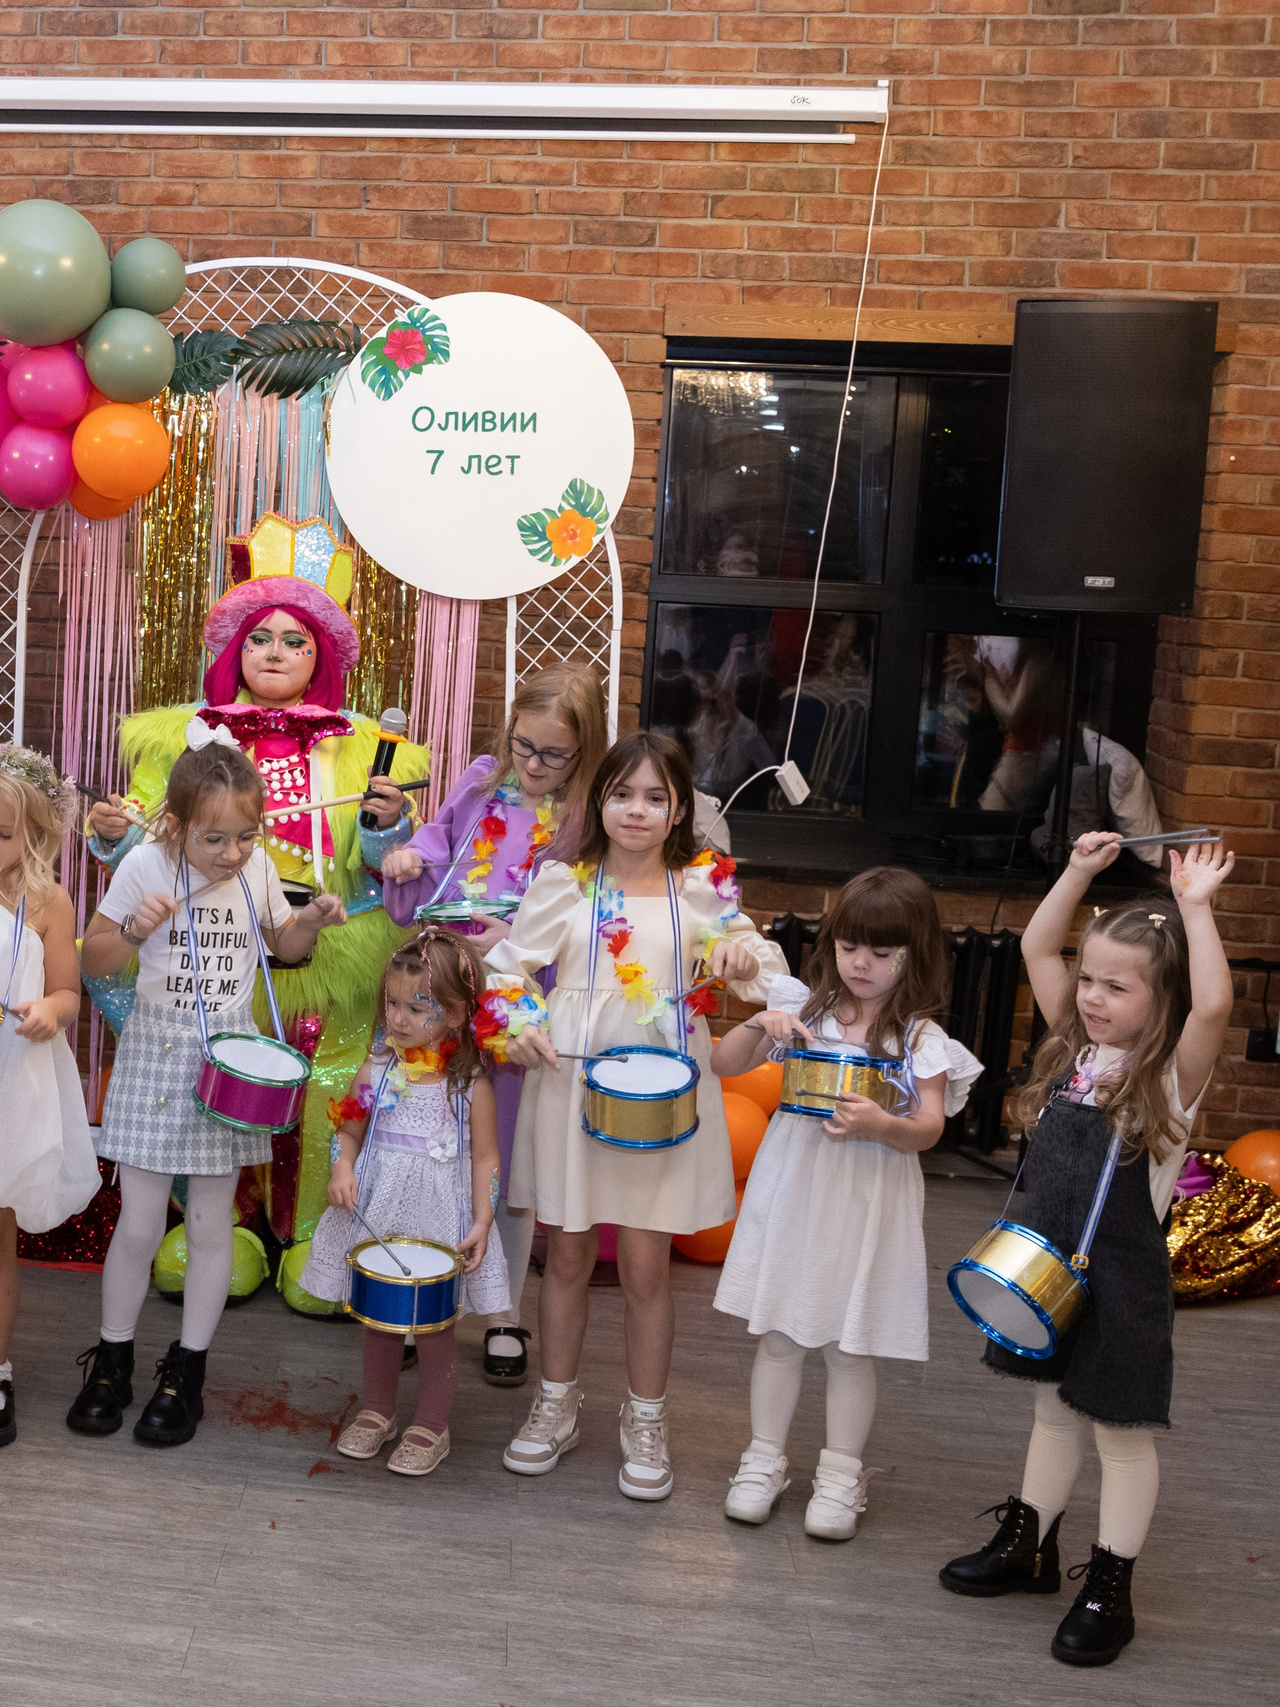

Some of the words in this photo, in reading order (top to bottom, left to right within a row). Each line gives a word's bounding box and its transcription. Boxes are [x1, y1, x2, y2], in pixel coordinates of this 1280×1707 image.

[411, 405, 537, 433] Оливии
[426, 449, 445, 475] 7
[460, 454, 521, 476] лет
[191, 907, 219, 925] IT'S
[225, 908, 234, 925] A
[216, 955, 233, 972] TO
[218, 979, 240, 996] ME
